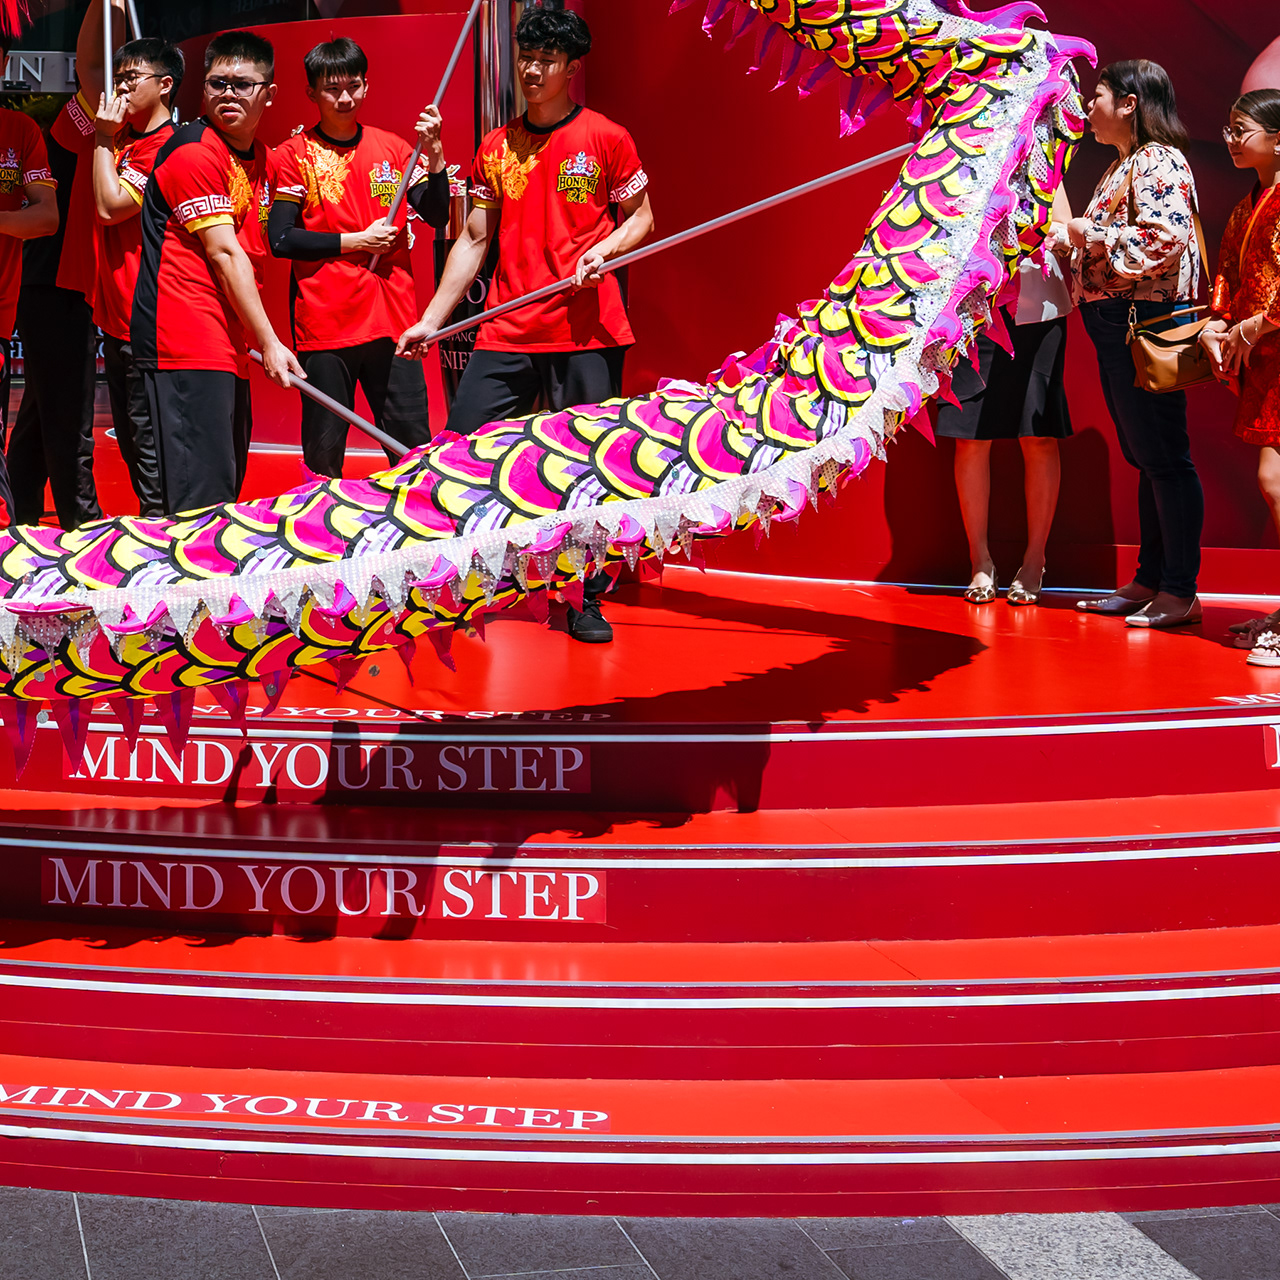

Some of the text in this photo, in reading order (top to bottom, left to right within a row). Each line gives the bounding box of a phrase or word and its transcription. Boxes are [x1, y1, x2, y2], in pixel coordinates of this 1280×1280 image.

[278, 706, 446, 720] YOUR
[463, 710, 613, 721] STEP
[69, 736, 585, 792] MIND YOUR STEP
[47, 857, 600, 921] MIND YOUR STEP
[202, 1093, 410, 1122] YOUR
[426, 1103, 610, 1130] STEP
